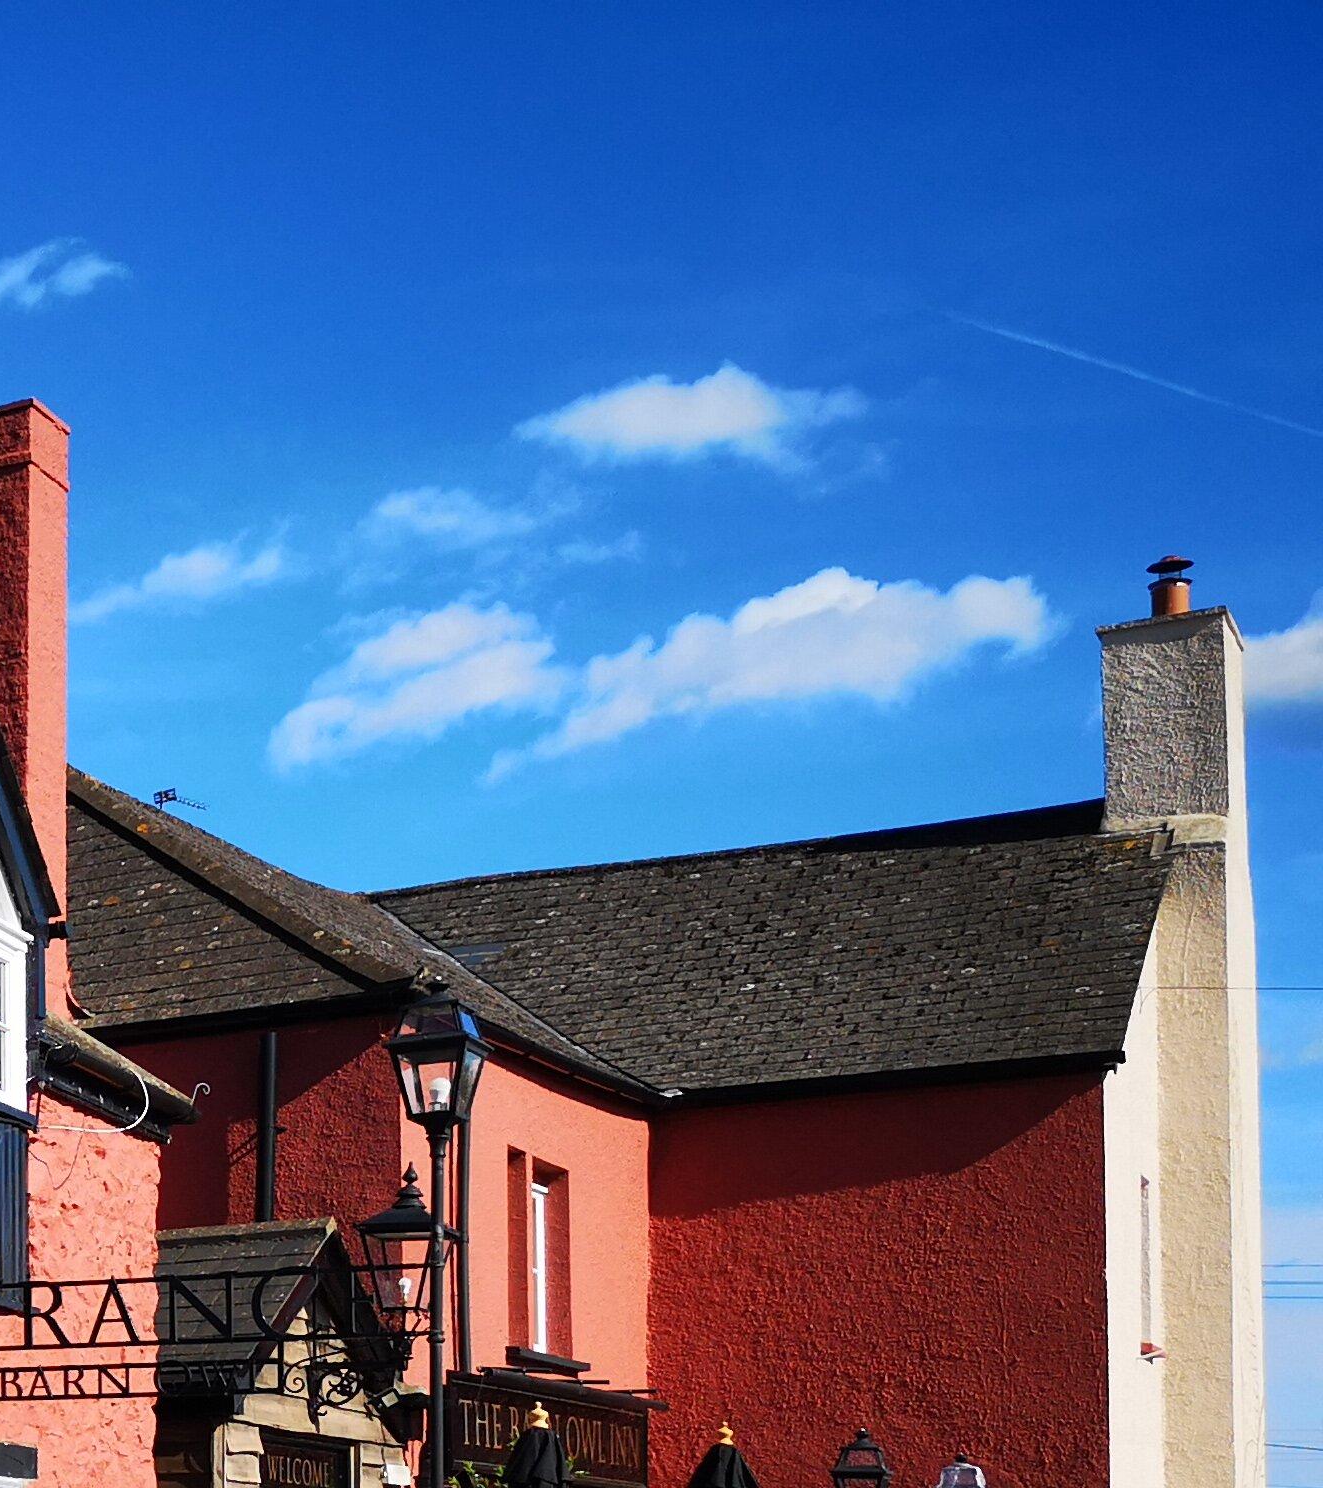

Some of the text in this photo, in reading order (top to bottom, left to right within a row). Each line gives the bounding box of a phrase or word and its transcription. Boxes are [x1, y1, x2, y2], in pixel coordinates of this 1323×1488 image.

[0, 1364, 135, 1400] BARN
[458, 1398, 503, 1450] THE
[565, 1415, 606, 1464] OWL
[609, 1422, 641, 1469] INN
[266, 1454, 330, 1488] WELCOME
